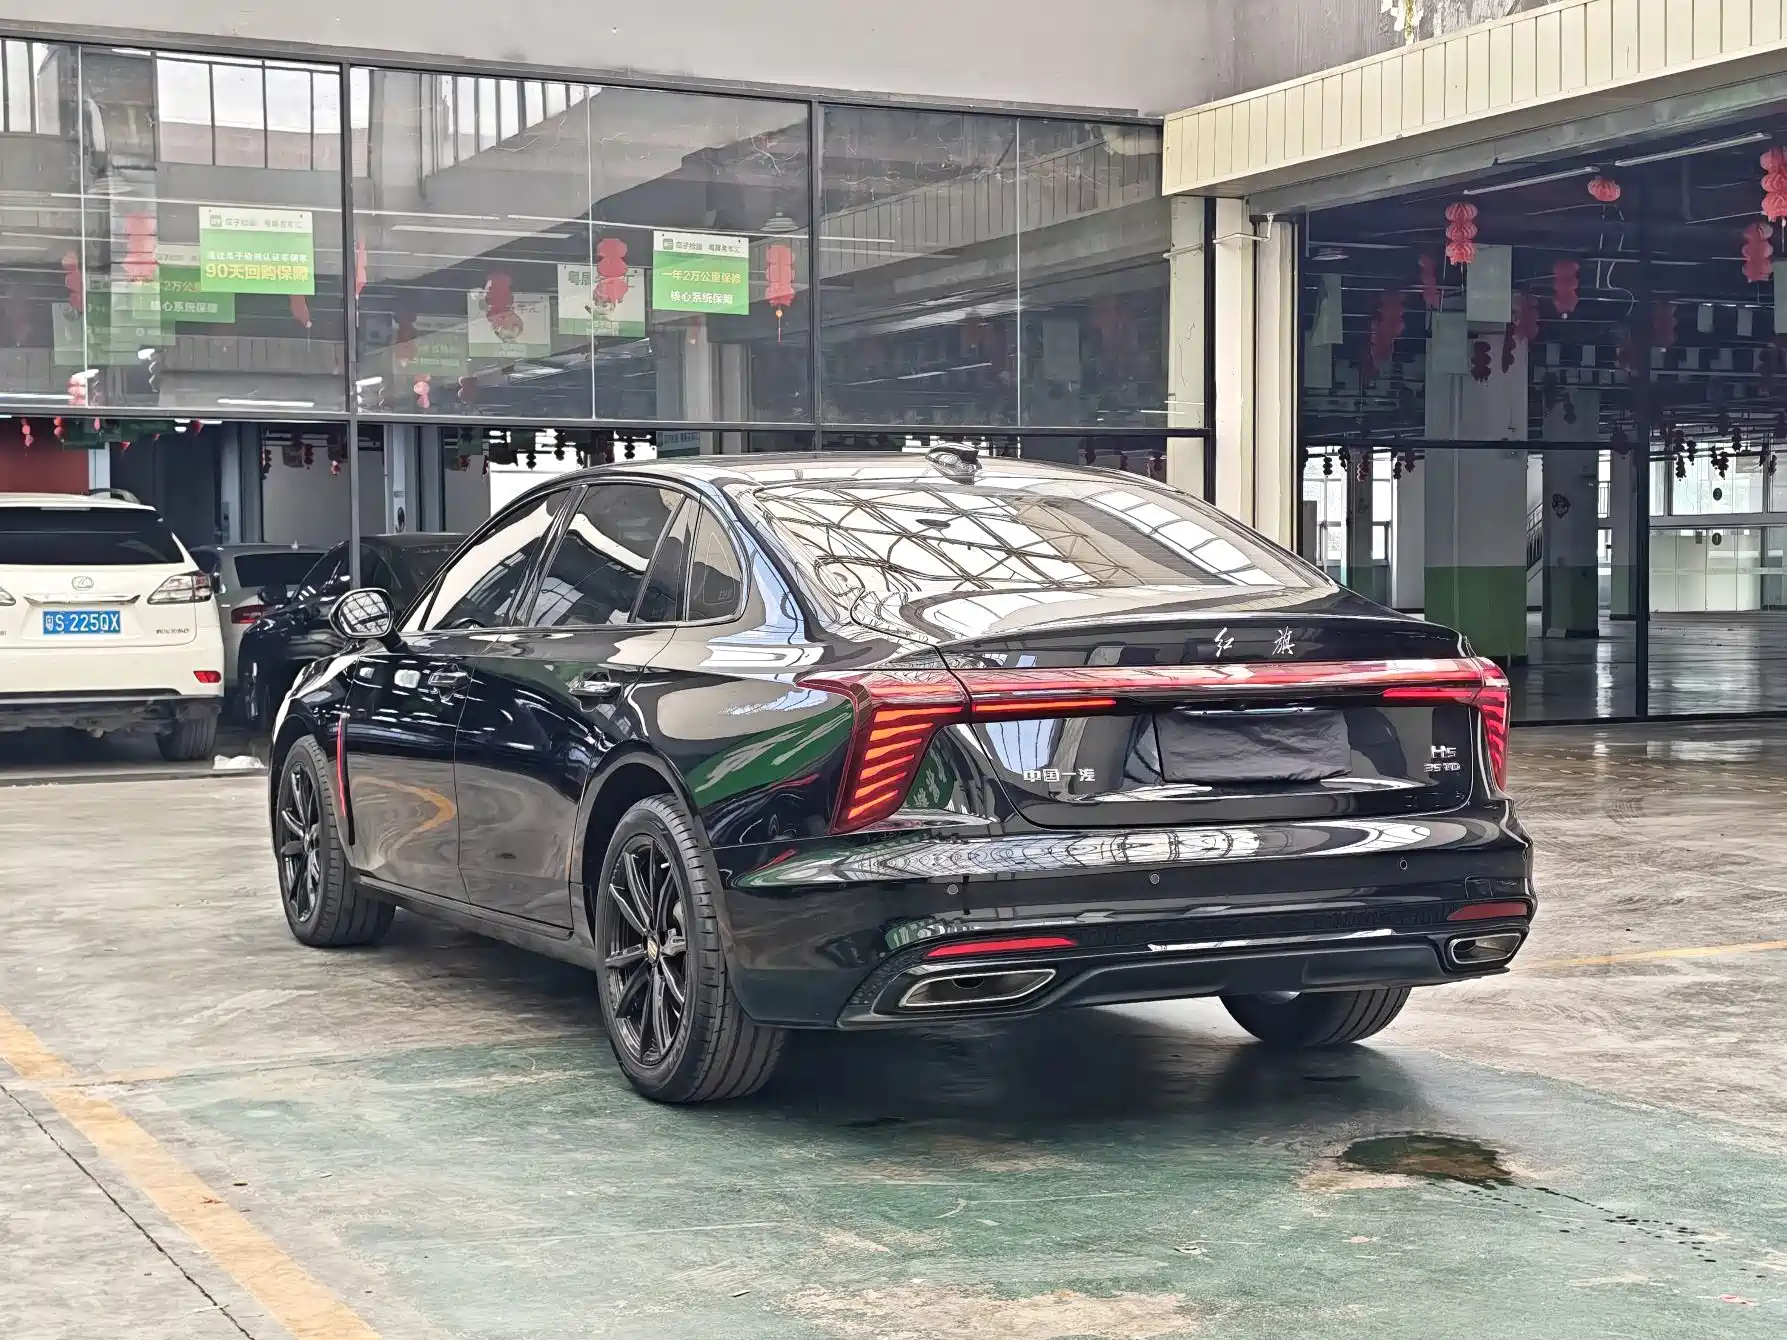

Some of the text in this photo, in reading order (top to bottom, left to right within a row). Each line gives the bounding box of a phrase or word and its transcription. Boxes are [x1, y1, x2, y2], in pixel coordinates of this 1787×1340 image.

[205, 263, 309, 281] 90天回购保障
[661, 269, 741, 284] 一年2万公里保修
[670, 290, 734, 304] 核心系统保障
[1431, 745, 1457, 758] H5
[1023, 768, 1096, 783] 中国一汽
